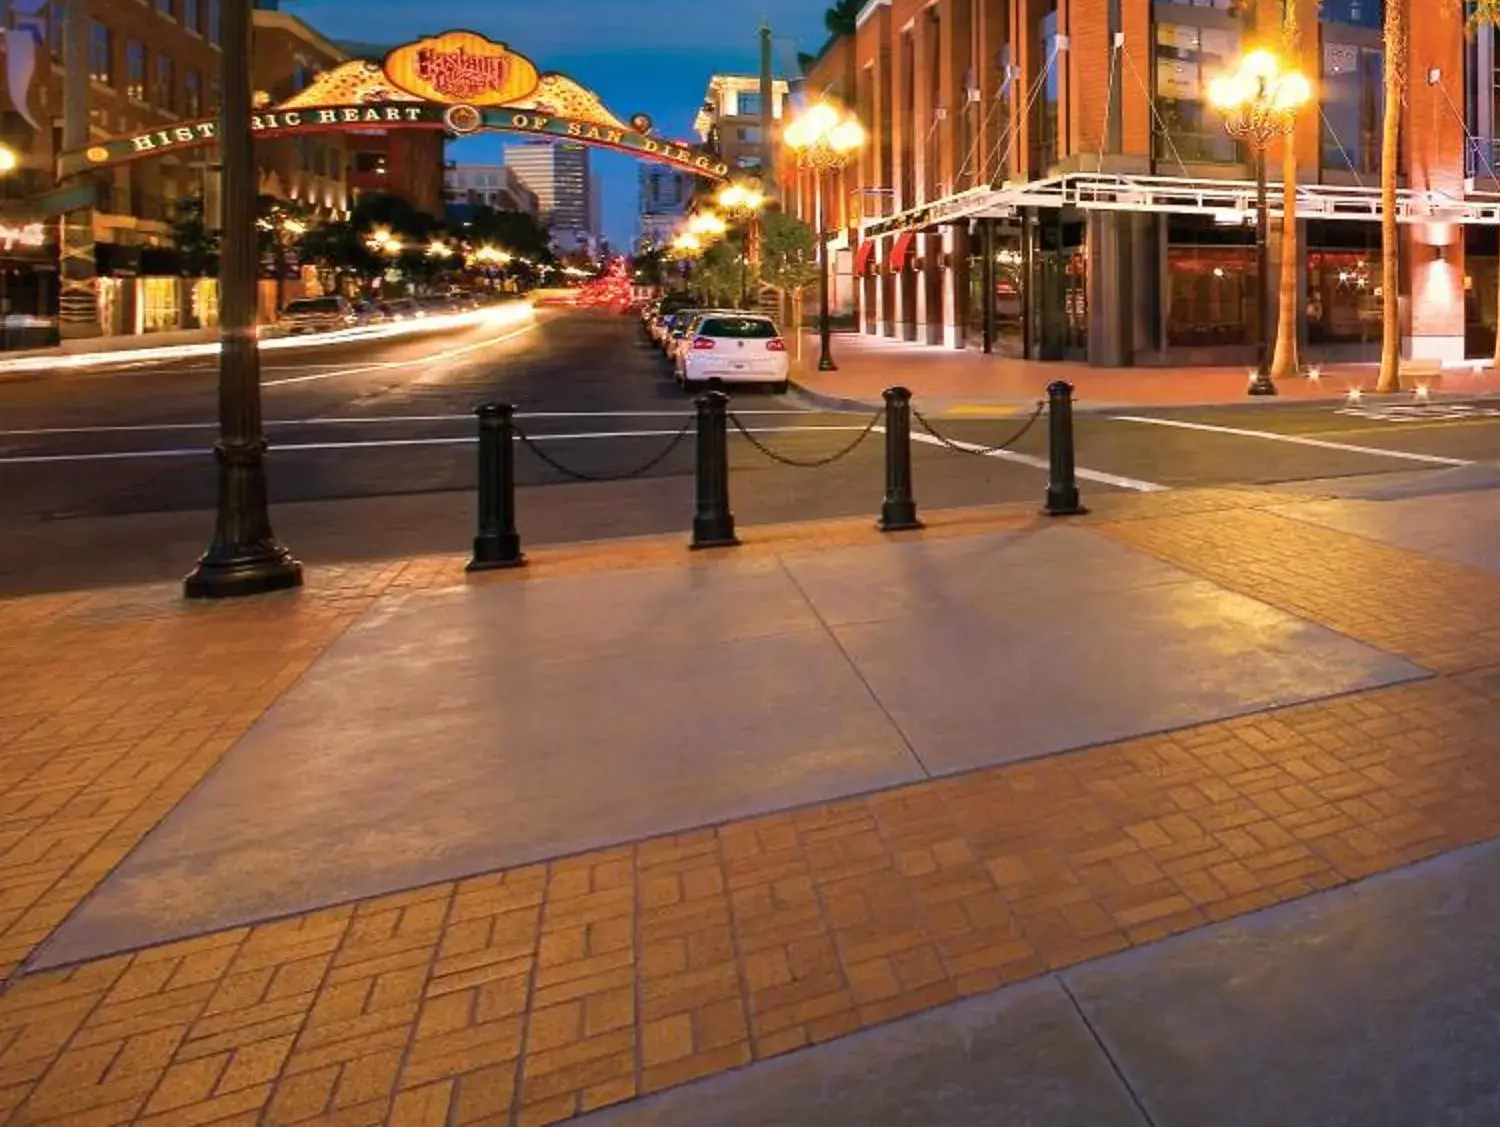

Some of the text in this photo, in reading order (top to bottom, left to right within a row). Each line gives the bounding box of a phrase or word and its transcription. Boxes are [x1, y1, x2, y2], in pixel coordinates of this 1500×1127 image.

[131, 107, 729, 176] HISTRIC HEART OF SAN DIEGO
